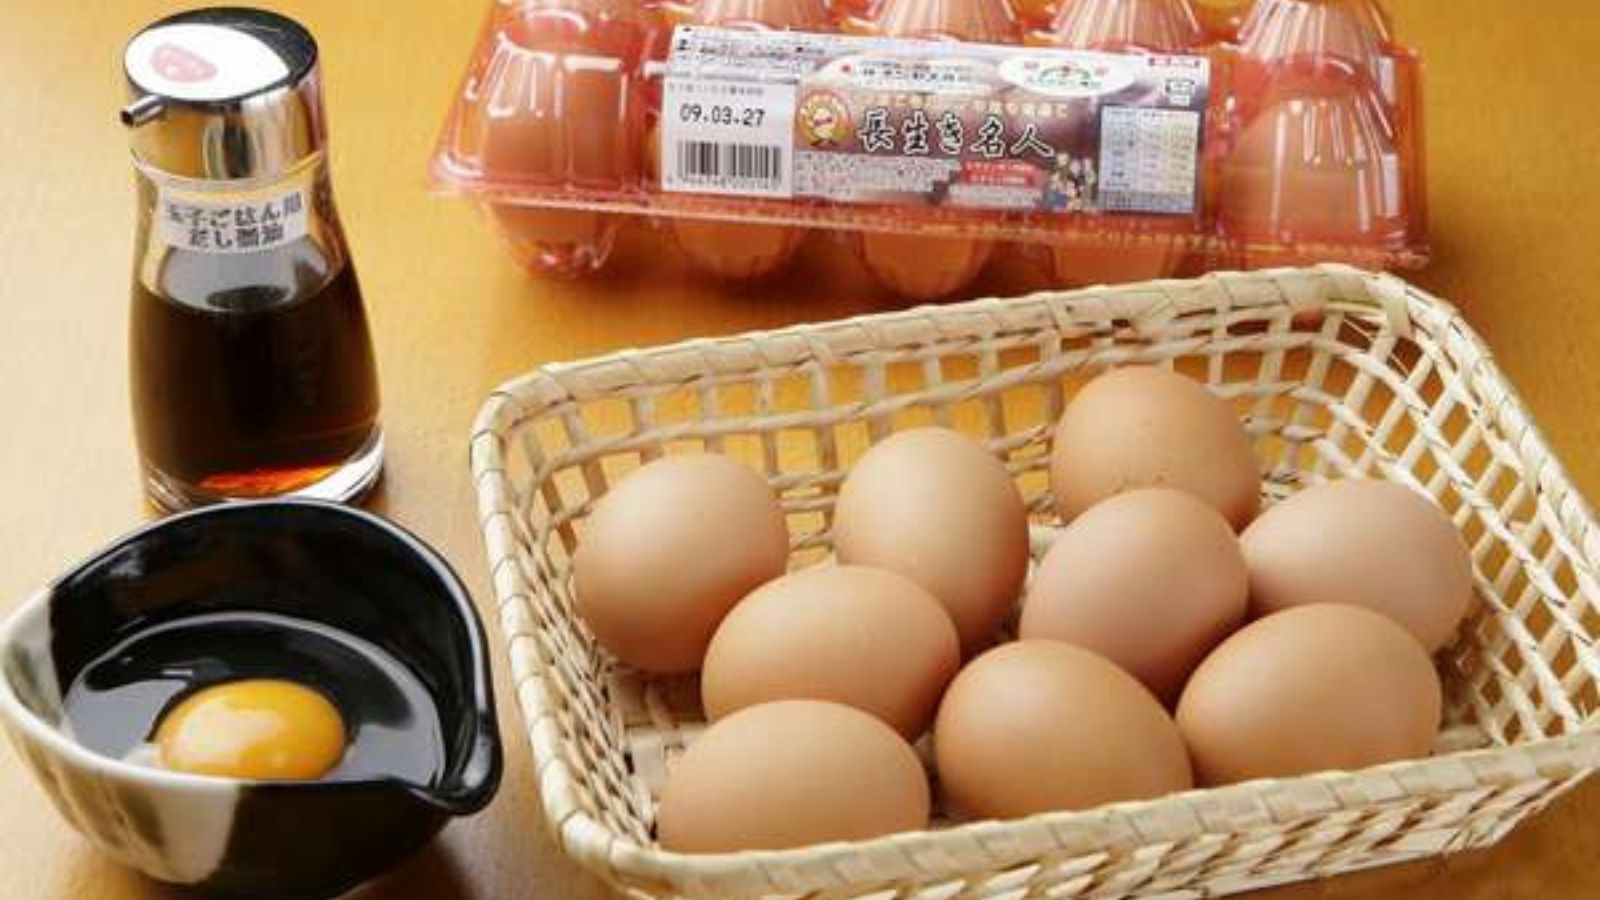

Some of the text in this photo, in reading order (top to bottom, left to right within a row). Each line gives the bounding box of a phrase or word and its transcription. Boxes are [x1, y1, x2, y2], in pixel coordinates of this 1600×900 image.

[680, 103, 765, 126] 09.03.27
[858, 107, 1055, 158] 長生き名人
